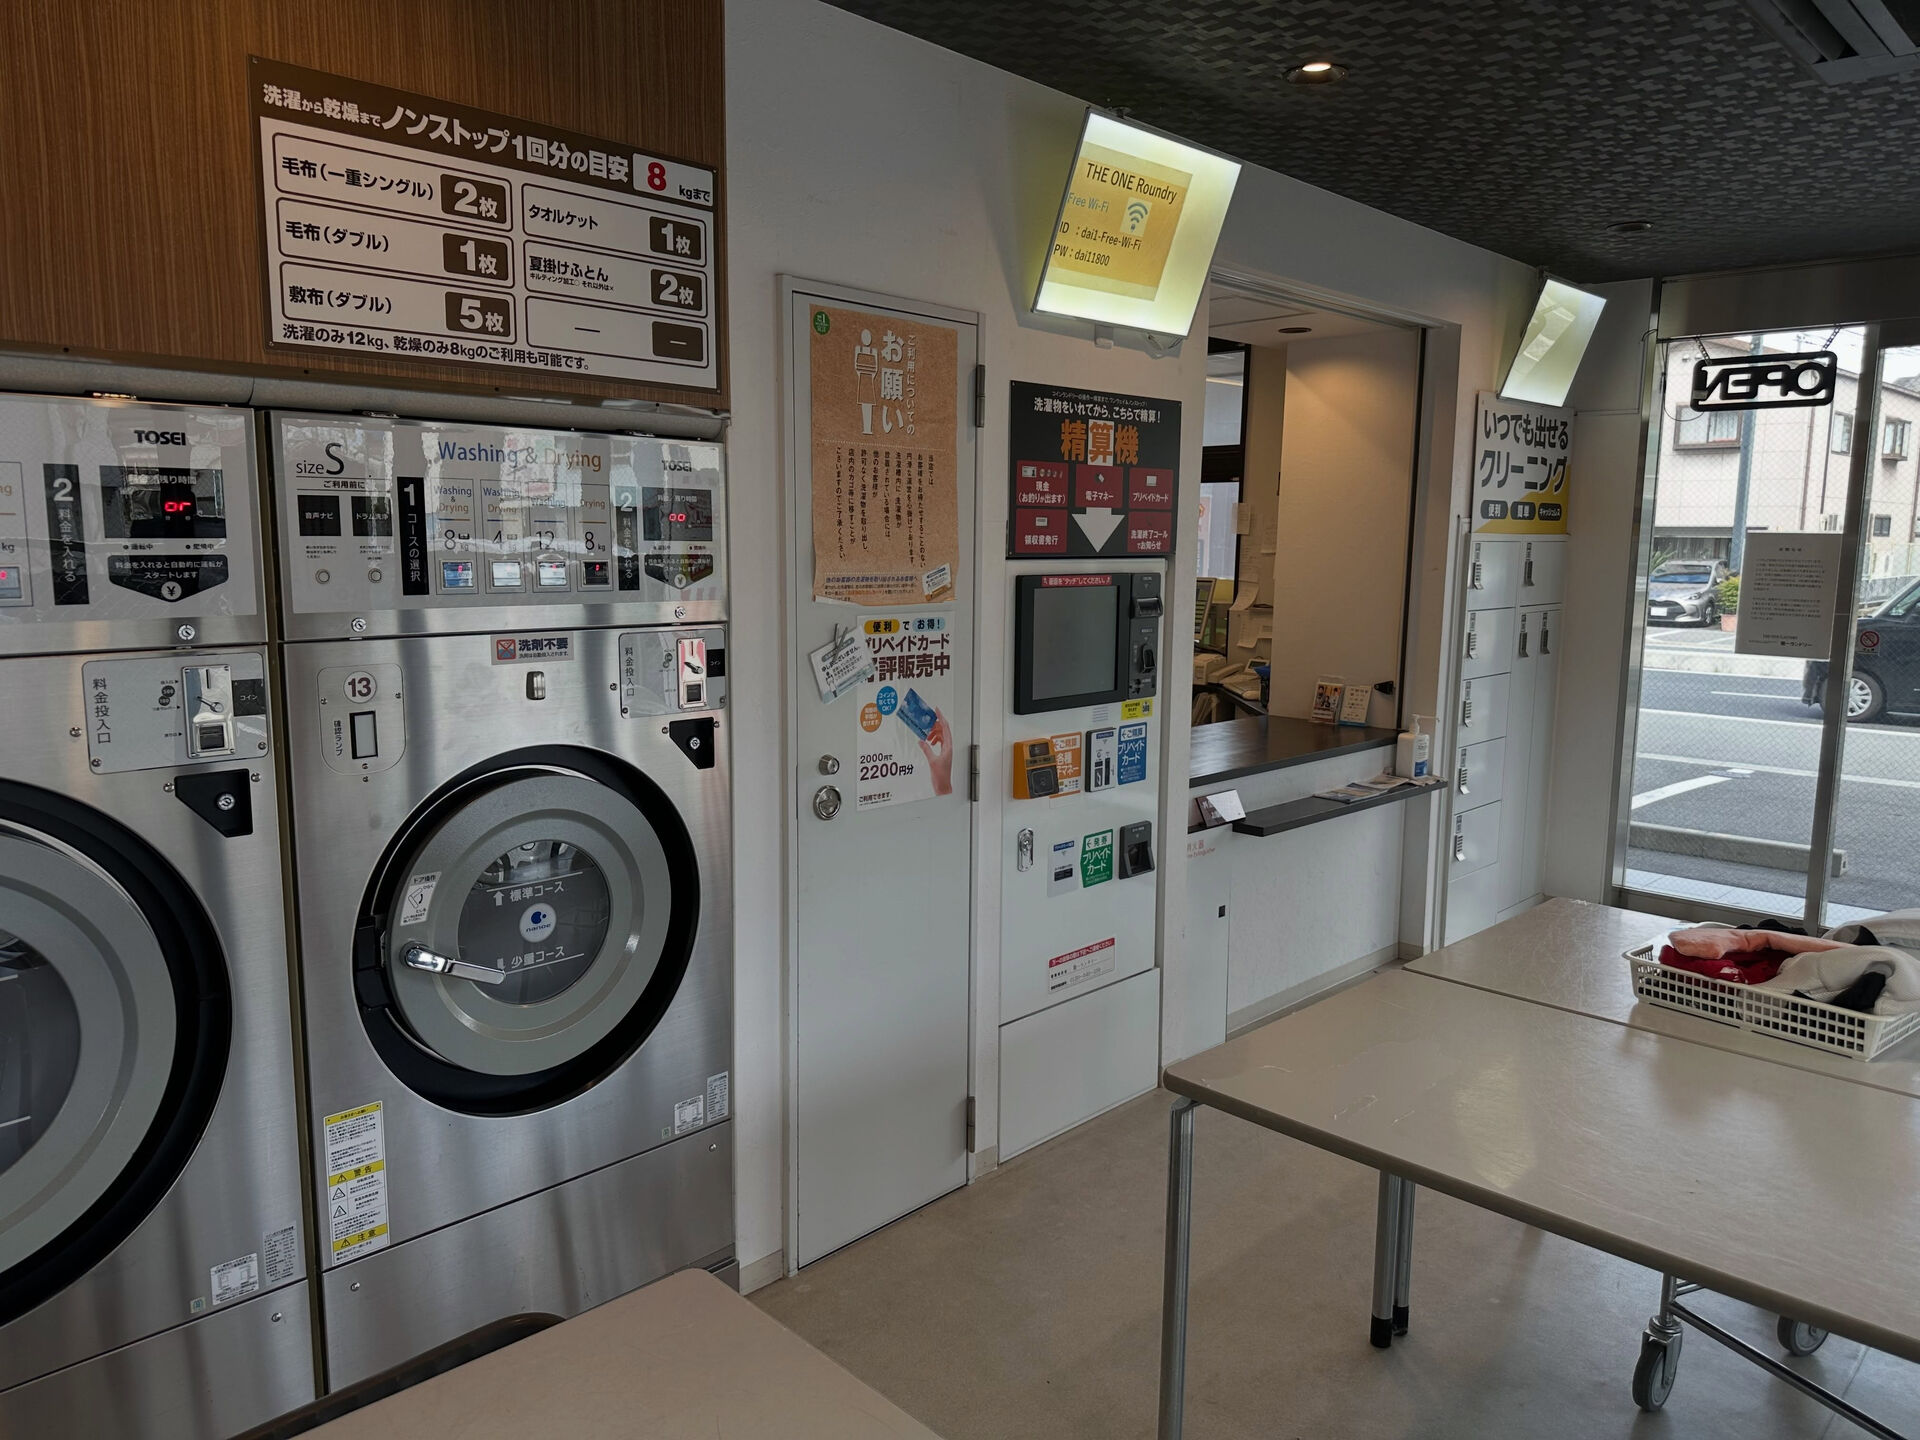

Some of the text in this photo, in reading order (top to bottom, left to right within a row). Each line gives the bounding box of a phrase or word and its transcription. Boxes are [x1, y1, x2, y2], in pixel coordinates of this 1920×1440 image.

[281, 157, 435, 200] 毛布（一重シングル）
[647, 161, 711, 203] 8 kgまで
[1086, 162, 1178, 205] THE ONE Roundry
[453, 181, 499, 218] 2枚
[1066, 192, 1110, 213] Free Wi-Fi
[528, 204, 599, 230] タオルケット
[285, 220, 390, 252] 毛布（ダブル）
[1059, 222, 1070, 234] ID
[660, 223, 692, 256] 1枚
[459, 239, 498, 276] 1枚
[1053, 244, 1069, 258] PW
[529, 255, 609, 283] 夏掛けふとん
[288, 284, 392, 315] 敷布（ダブル）
[658, 272, 695, 307] 2枚
[459, 297, 505, 333] 5枚
[881, 329, 905, 434] お願い
[906, 334, 916, 436] ご利用についての
[133, 429, 187, 446] TOSEI
[1483, 409, 1569, 450] いつでも出せる
[1060, 418, 1139, 465] 精算機
[295, 442, 345, 475] size S
[438, 441, 602, 473] Washing & Drying
[661, 460, 693, 473] TOSEI
[1479, 449, 1568, 493] クリーニング
[52, 477, 75, 503] 2
[323, 480, 366, 489] ご利用前に
[403, 483, 416, 507] 1
[434, 484, 473, 497] Washing
[1035, 480, 1050, 492] 現金
[580, 498, 606, 510] Drying
[620, 491, 634, 513] 2
[1085, 490, 1114, 502] 電子マネー
[1132, 492, 1169, 503] プリペイドカード
[304, 511, 335, 520] 音声ナビ
[439, 502, 469, 515] Drying
[1488, 503, 1502, 518] 便利
[56, 507, 77, 583] 料金を入れる
[407, 513, 422, 583] コースの選択
[444, 529, 456, 550] 8
[535, 530, 556, 551] 12
[584, 531, 606, 553] 8 kg
[622, 517, 633, 580] 料金を入れる
[144, 571, 199, 580] スタートします
[872, 620, 892, 633] 便利
[902, 621, 910, 631] で
[917, 619, 941, 630] お得！
[518, 637, 569, 652] 洗剤不要
[624, 646, 635, 698] 料金投入口
[240, 693, 259, 702] コイン
[347, 677, 372, 697] 13
[92, 677, 112, 745] 料金投入口
[1118, 740, 1145, 755] プリペイド
[859, 753, 893, 765] 2000円で
[1122, 753, 1141, 766] カード
[859, 762, 914, 782] 2200円分
[1082, 846, 1111, 865] プリペイド
[1086, 859, 1107, 876] カード
[510, 881, 565, 903] 標準コース
[525, 923, 551, 933] nanoe
[511, 946, 565, 969] 少量コース
